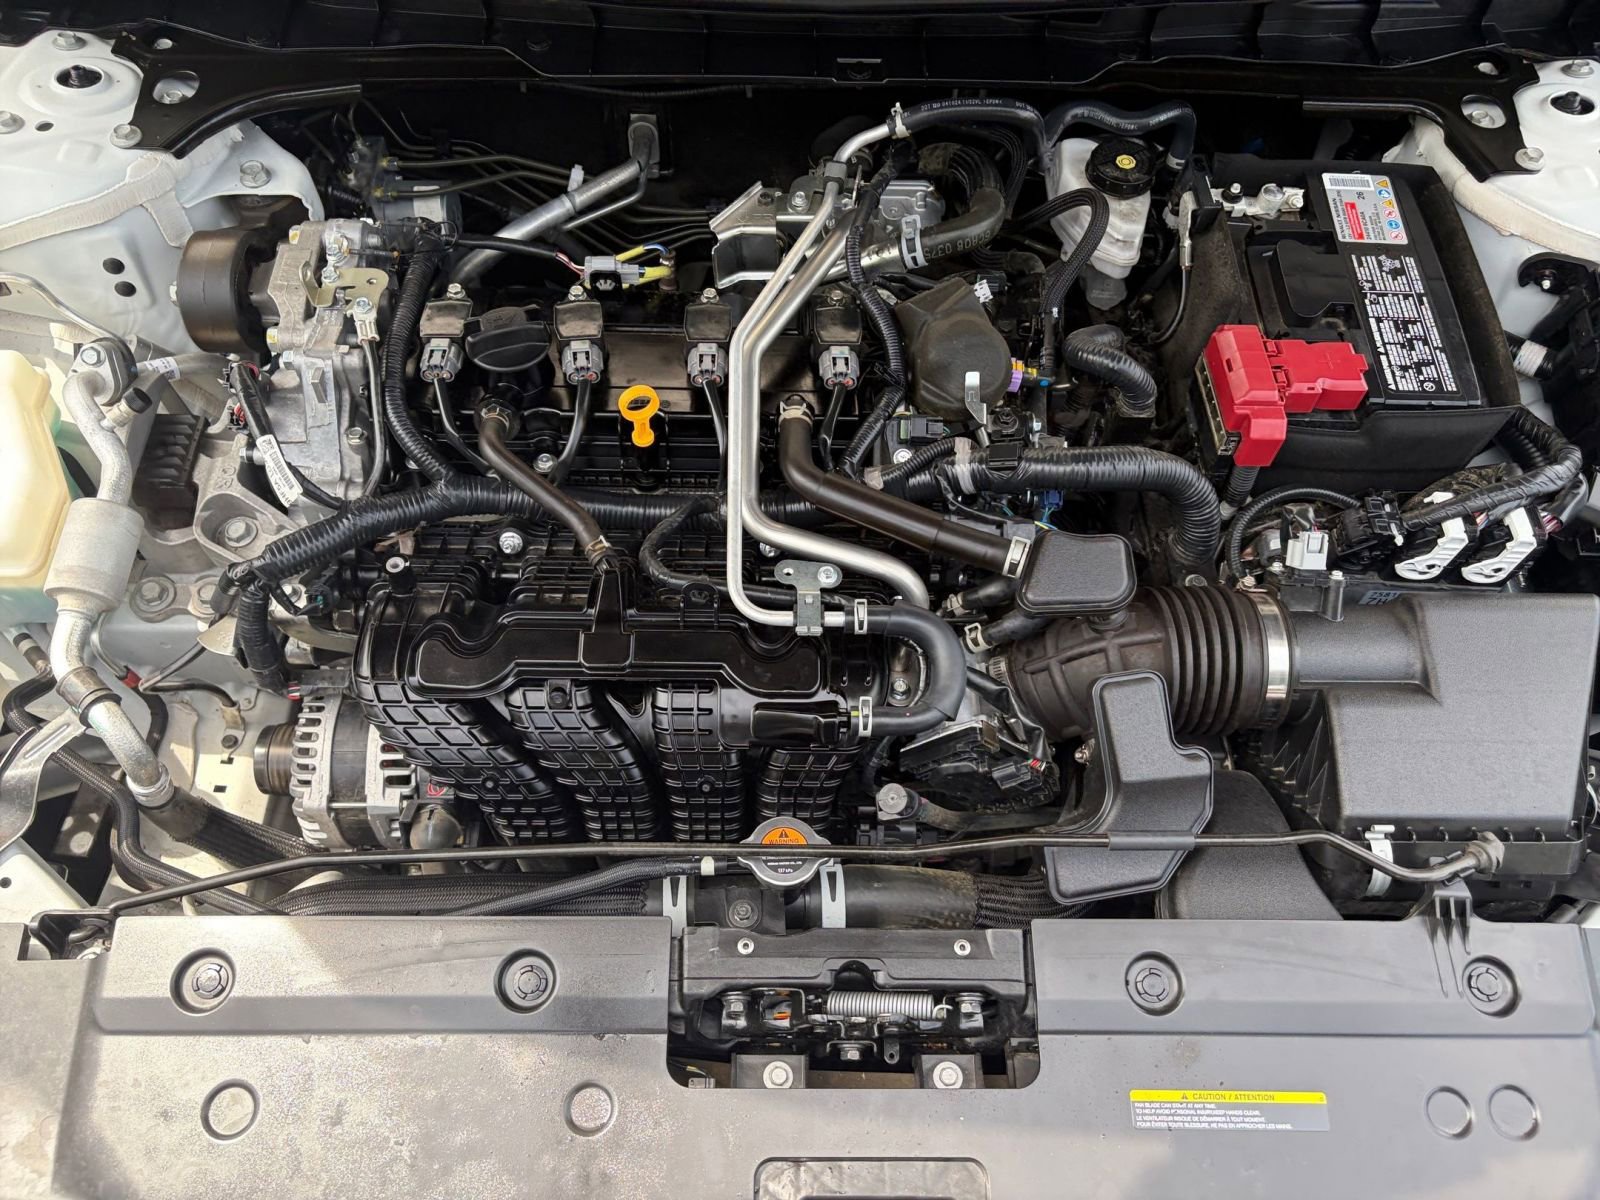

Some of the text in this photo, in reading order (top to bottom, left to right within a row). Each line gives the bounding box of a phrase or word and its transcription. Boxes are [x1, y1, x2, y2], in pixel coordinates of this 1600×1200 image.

[1356, 191, 1365, 200] 26
[1338, 219, 1347, 240] RENAULT
[1192, 1093, 1226, 1101] CAUTION
[1234, 1093, 1275, 1102] ATTENTION
